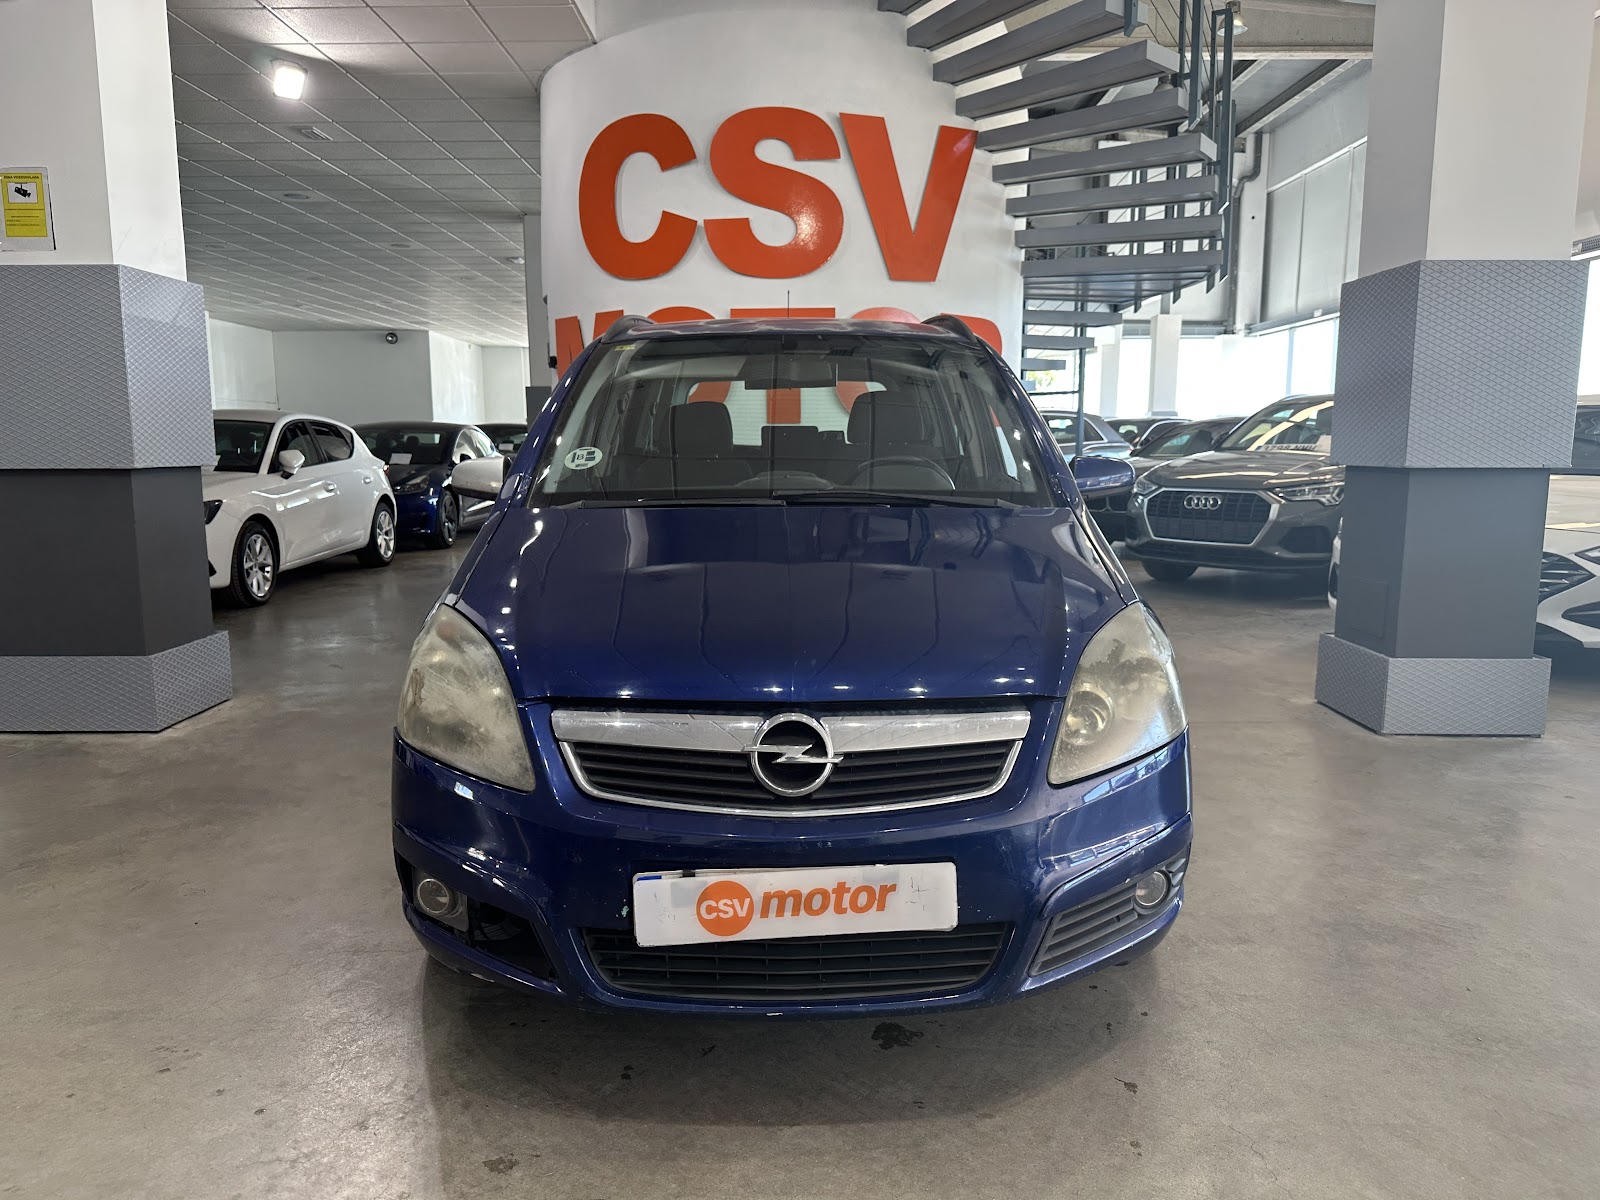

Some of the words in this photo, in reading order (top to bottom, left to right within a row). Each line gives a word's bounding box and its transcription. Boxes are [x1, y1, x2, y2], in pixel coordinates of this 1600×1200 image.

[579, 106, 979, 282] CSV
[700, 897, 751, 920] CSV
[759, 881, 897, 919] motor
